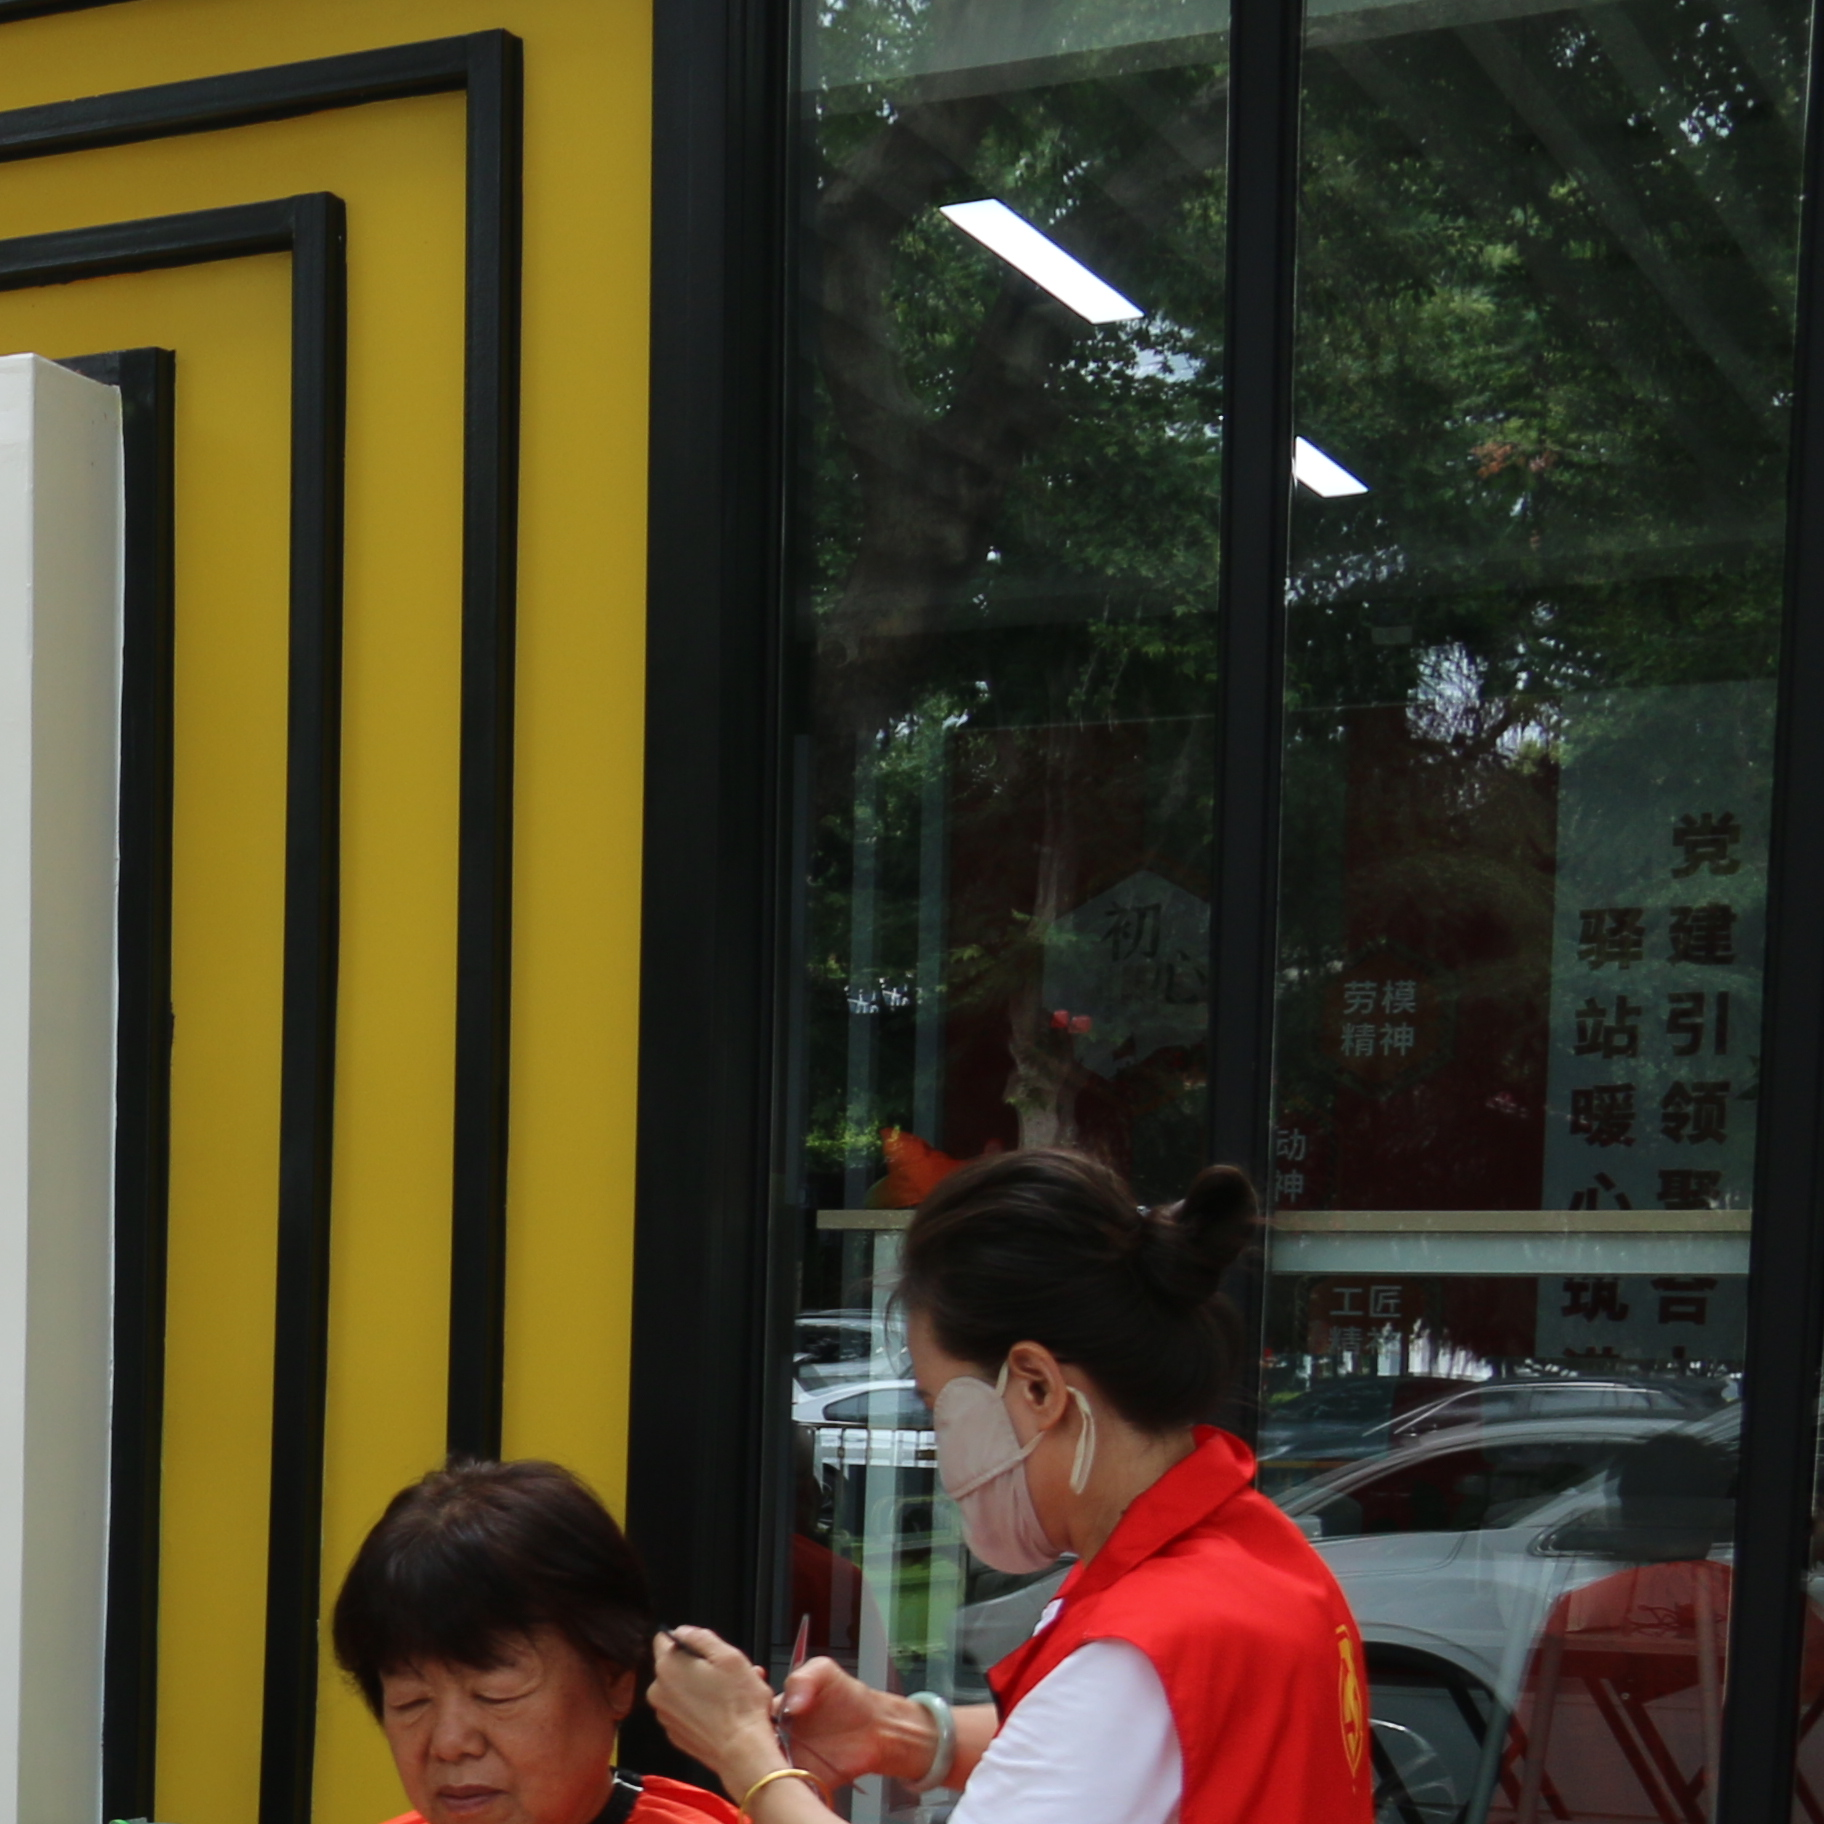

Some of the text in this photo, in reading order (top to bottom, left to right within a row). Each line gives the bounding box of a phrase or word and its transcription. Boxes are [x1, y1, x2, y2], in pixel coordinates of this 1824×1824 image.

[1342, 980, 1417, 1015] 劳模
[1341, 1023, 1415, 1056] 精神
[1652, 813, 1741, 1358] 党建引领聚合
[1560, 906, 1644, 1358] 驿站暖心筑
[1329, 1286, 1402, 1318] 工匠
